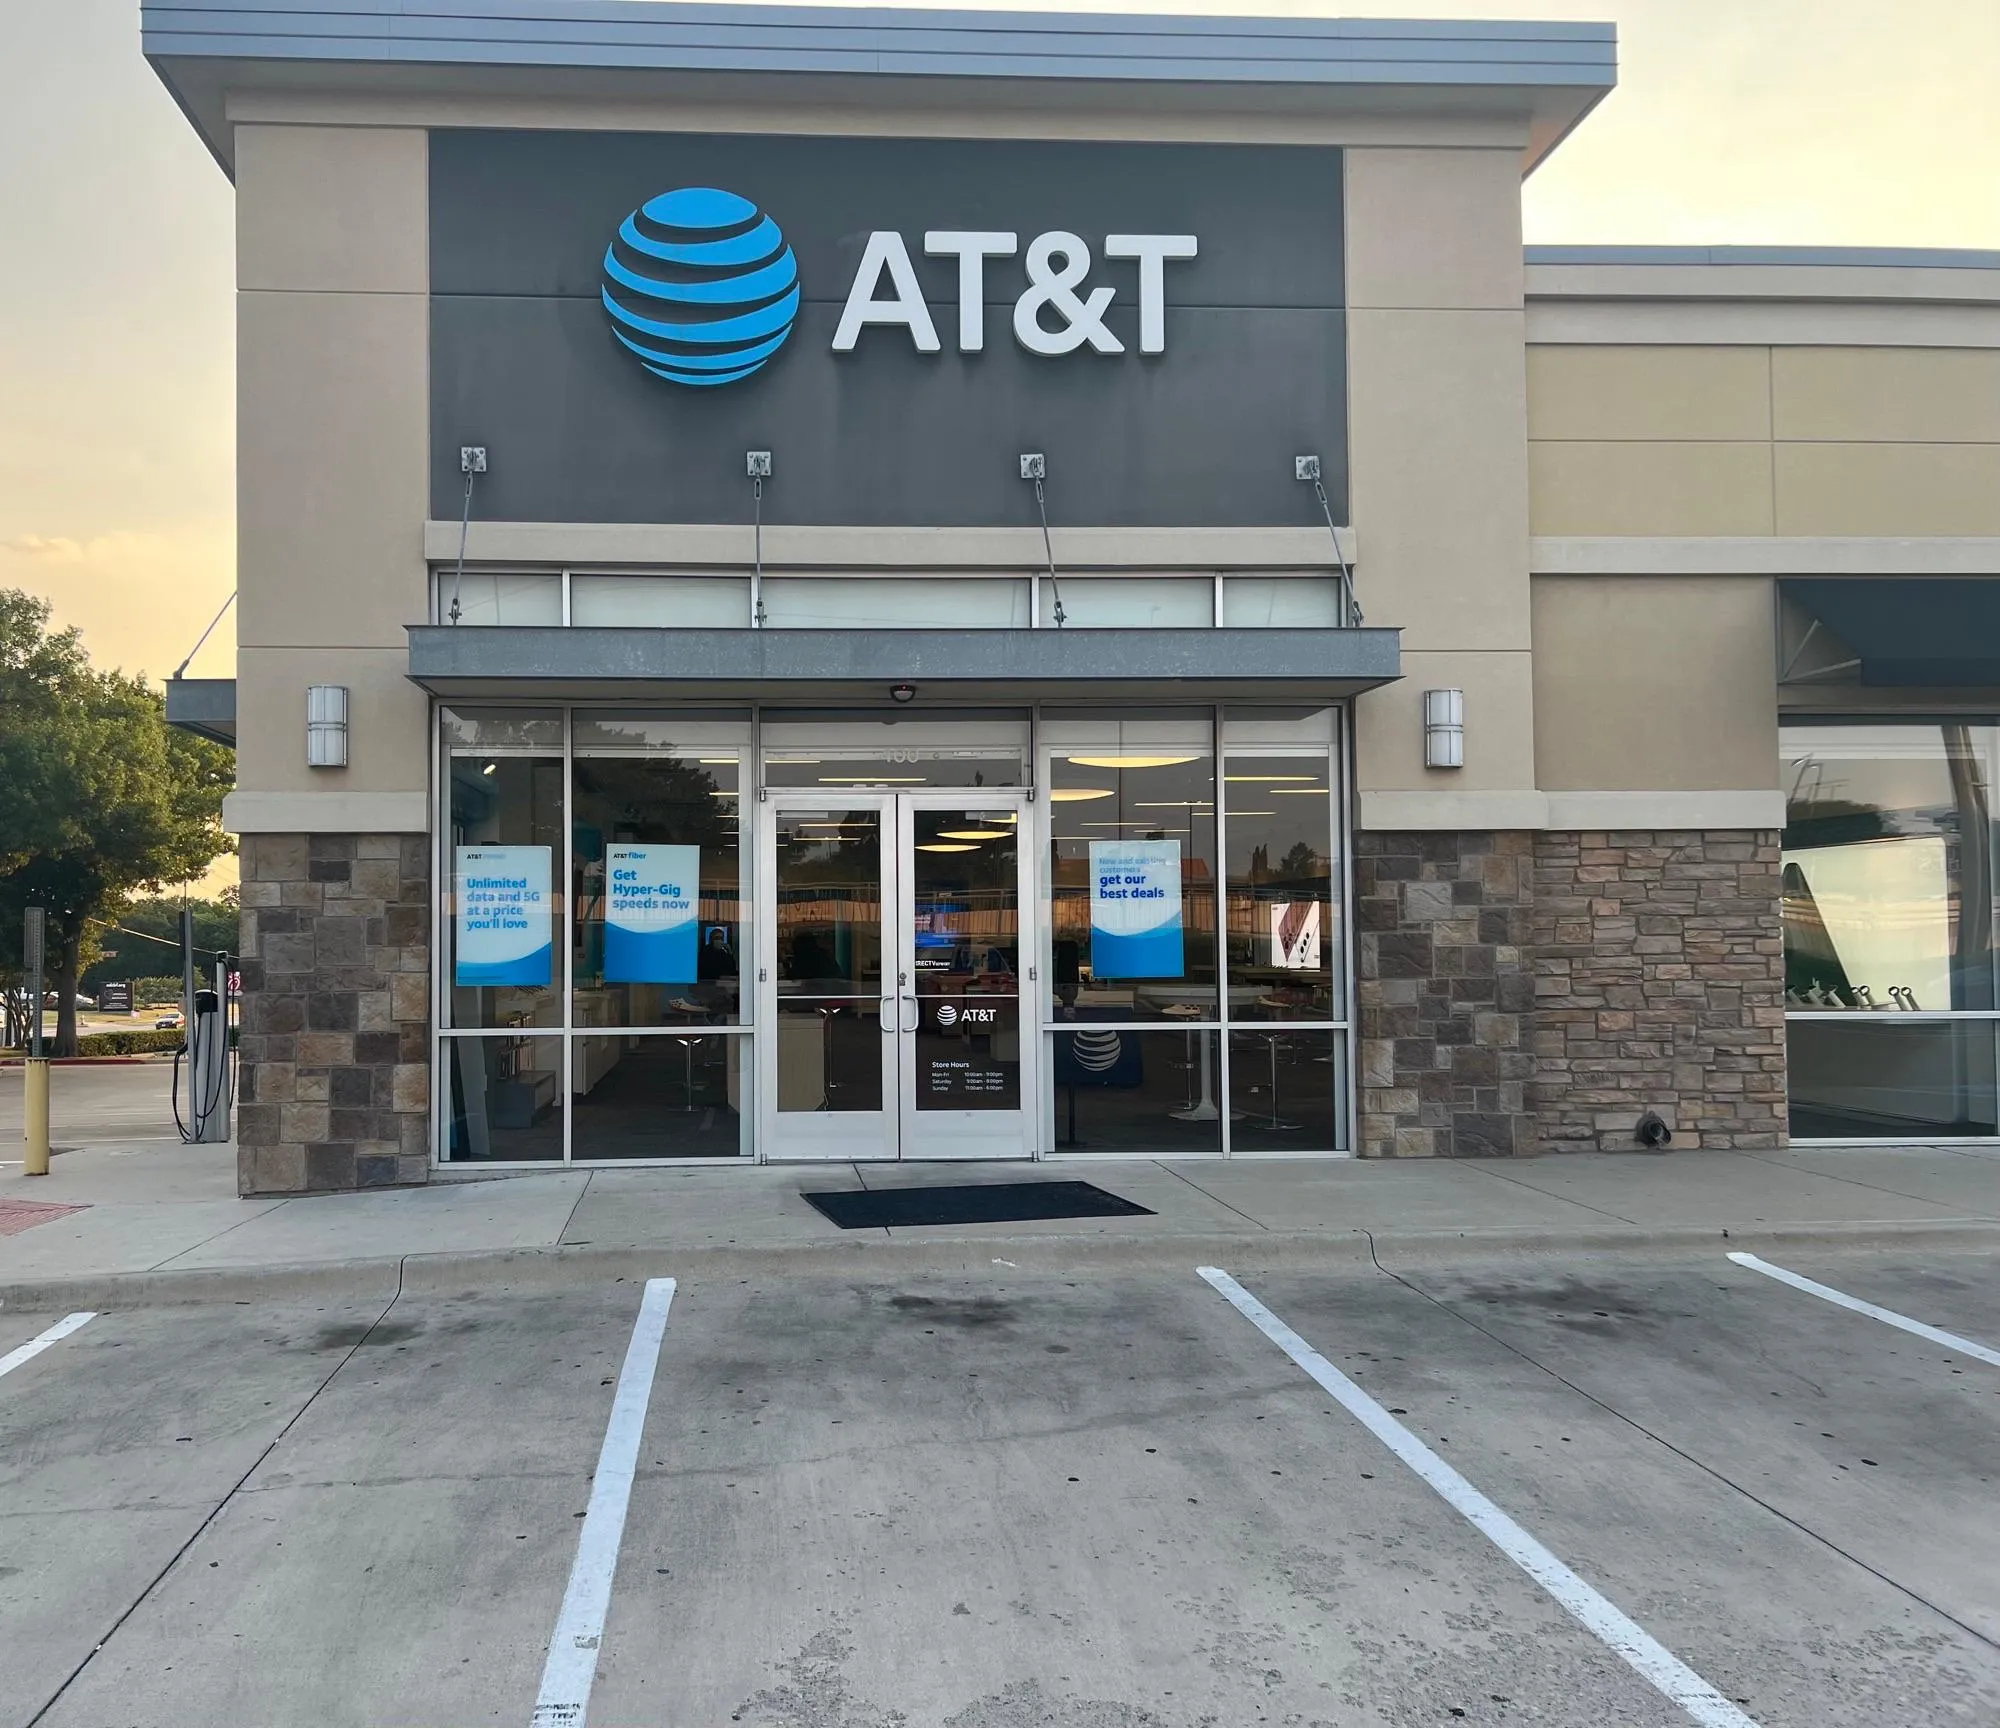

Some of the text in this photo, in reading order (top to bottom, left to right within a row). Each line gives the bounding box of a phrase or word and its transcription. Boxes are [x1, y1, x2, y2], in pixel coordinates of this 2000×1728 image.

[832, 231, 1198, 356] AT&T
[613, 870, 637, 880] Get
[1100, 875, 1146, 887] get our
[467, 878, 527, 888] Unlimited
[467, 890, 540, 902] data and 5G
[613, 884, 681, 898] Hyper-Gig
[1100, 887, 1164, 898] best deals
[612, 898, 690, 911] speeds now
[467, 905, 523, 917] at a price
[467, 918, 528, 932] you'll love
[961, 1009, 996, 1022] AT&T
